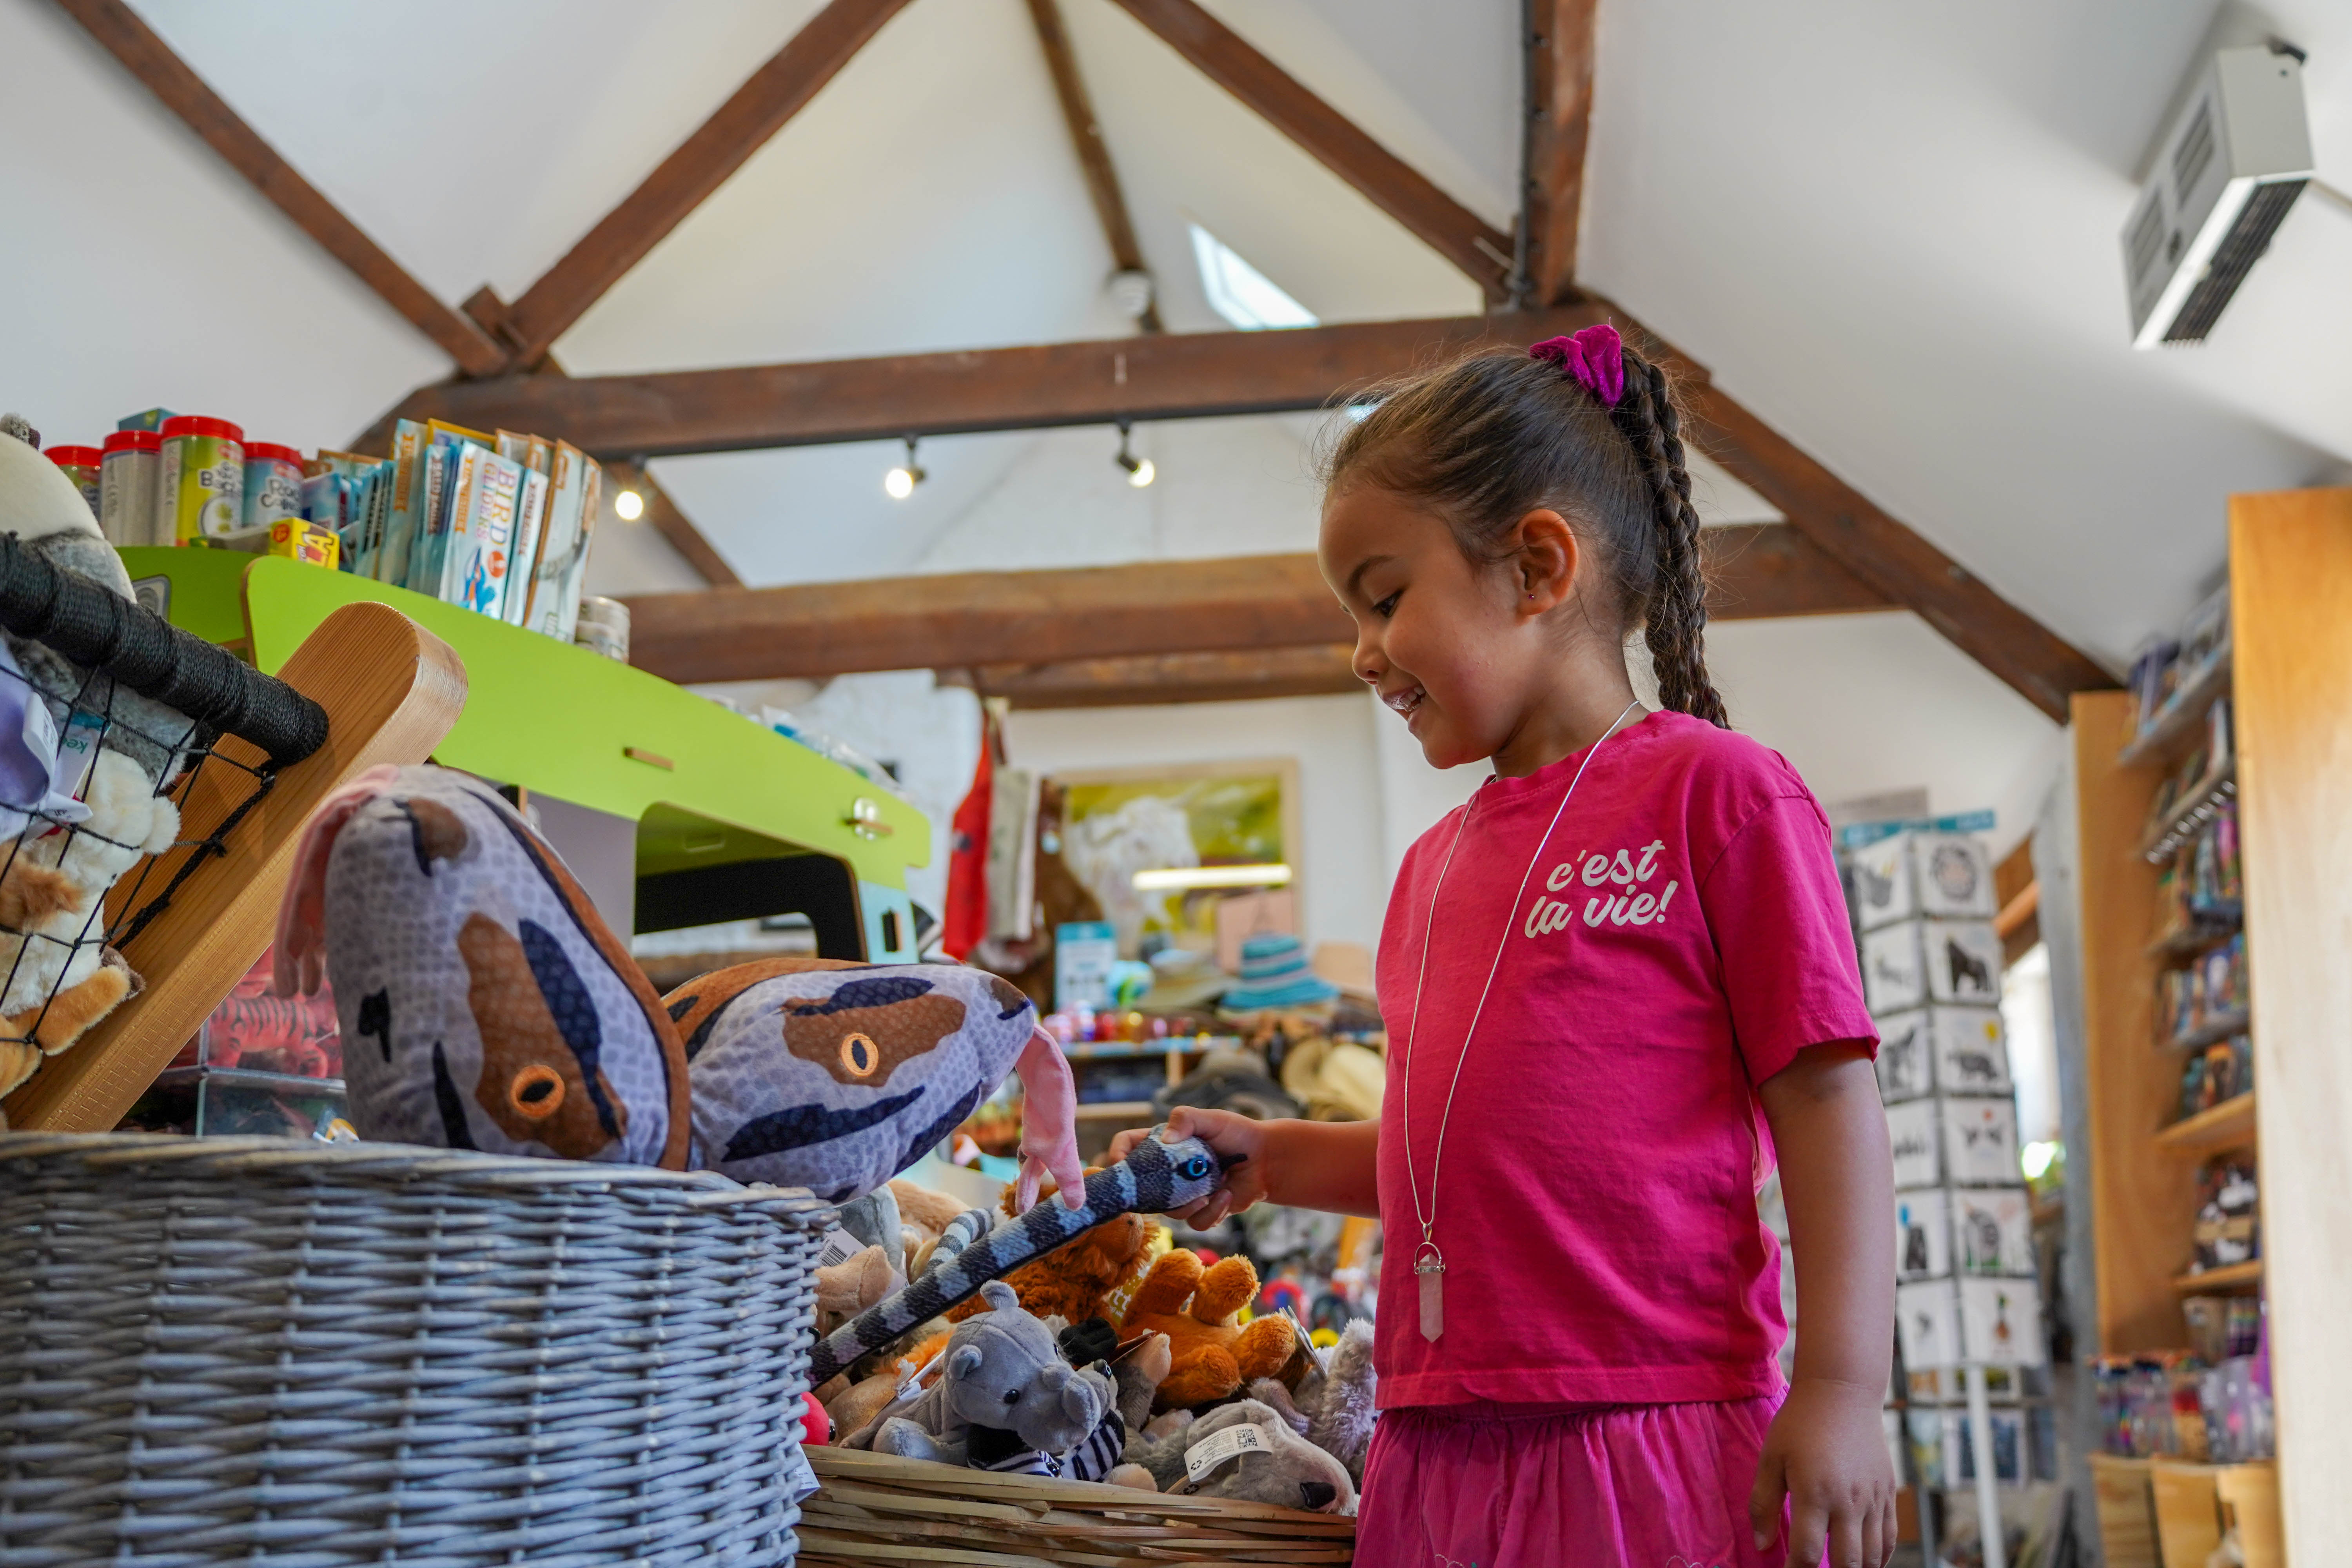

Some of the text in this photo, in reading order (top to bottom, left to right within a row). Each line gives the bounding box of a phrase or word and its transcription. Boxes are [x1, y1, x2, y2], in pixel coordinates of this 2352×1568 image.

[475, 462, 499, 541] GLIDERS
[490, 466, 517, 546] BIRD
[1546, 840, 1665, 891] c'est
[1524, 880, 1678, 938] la vie!
